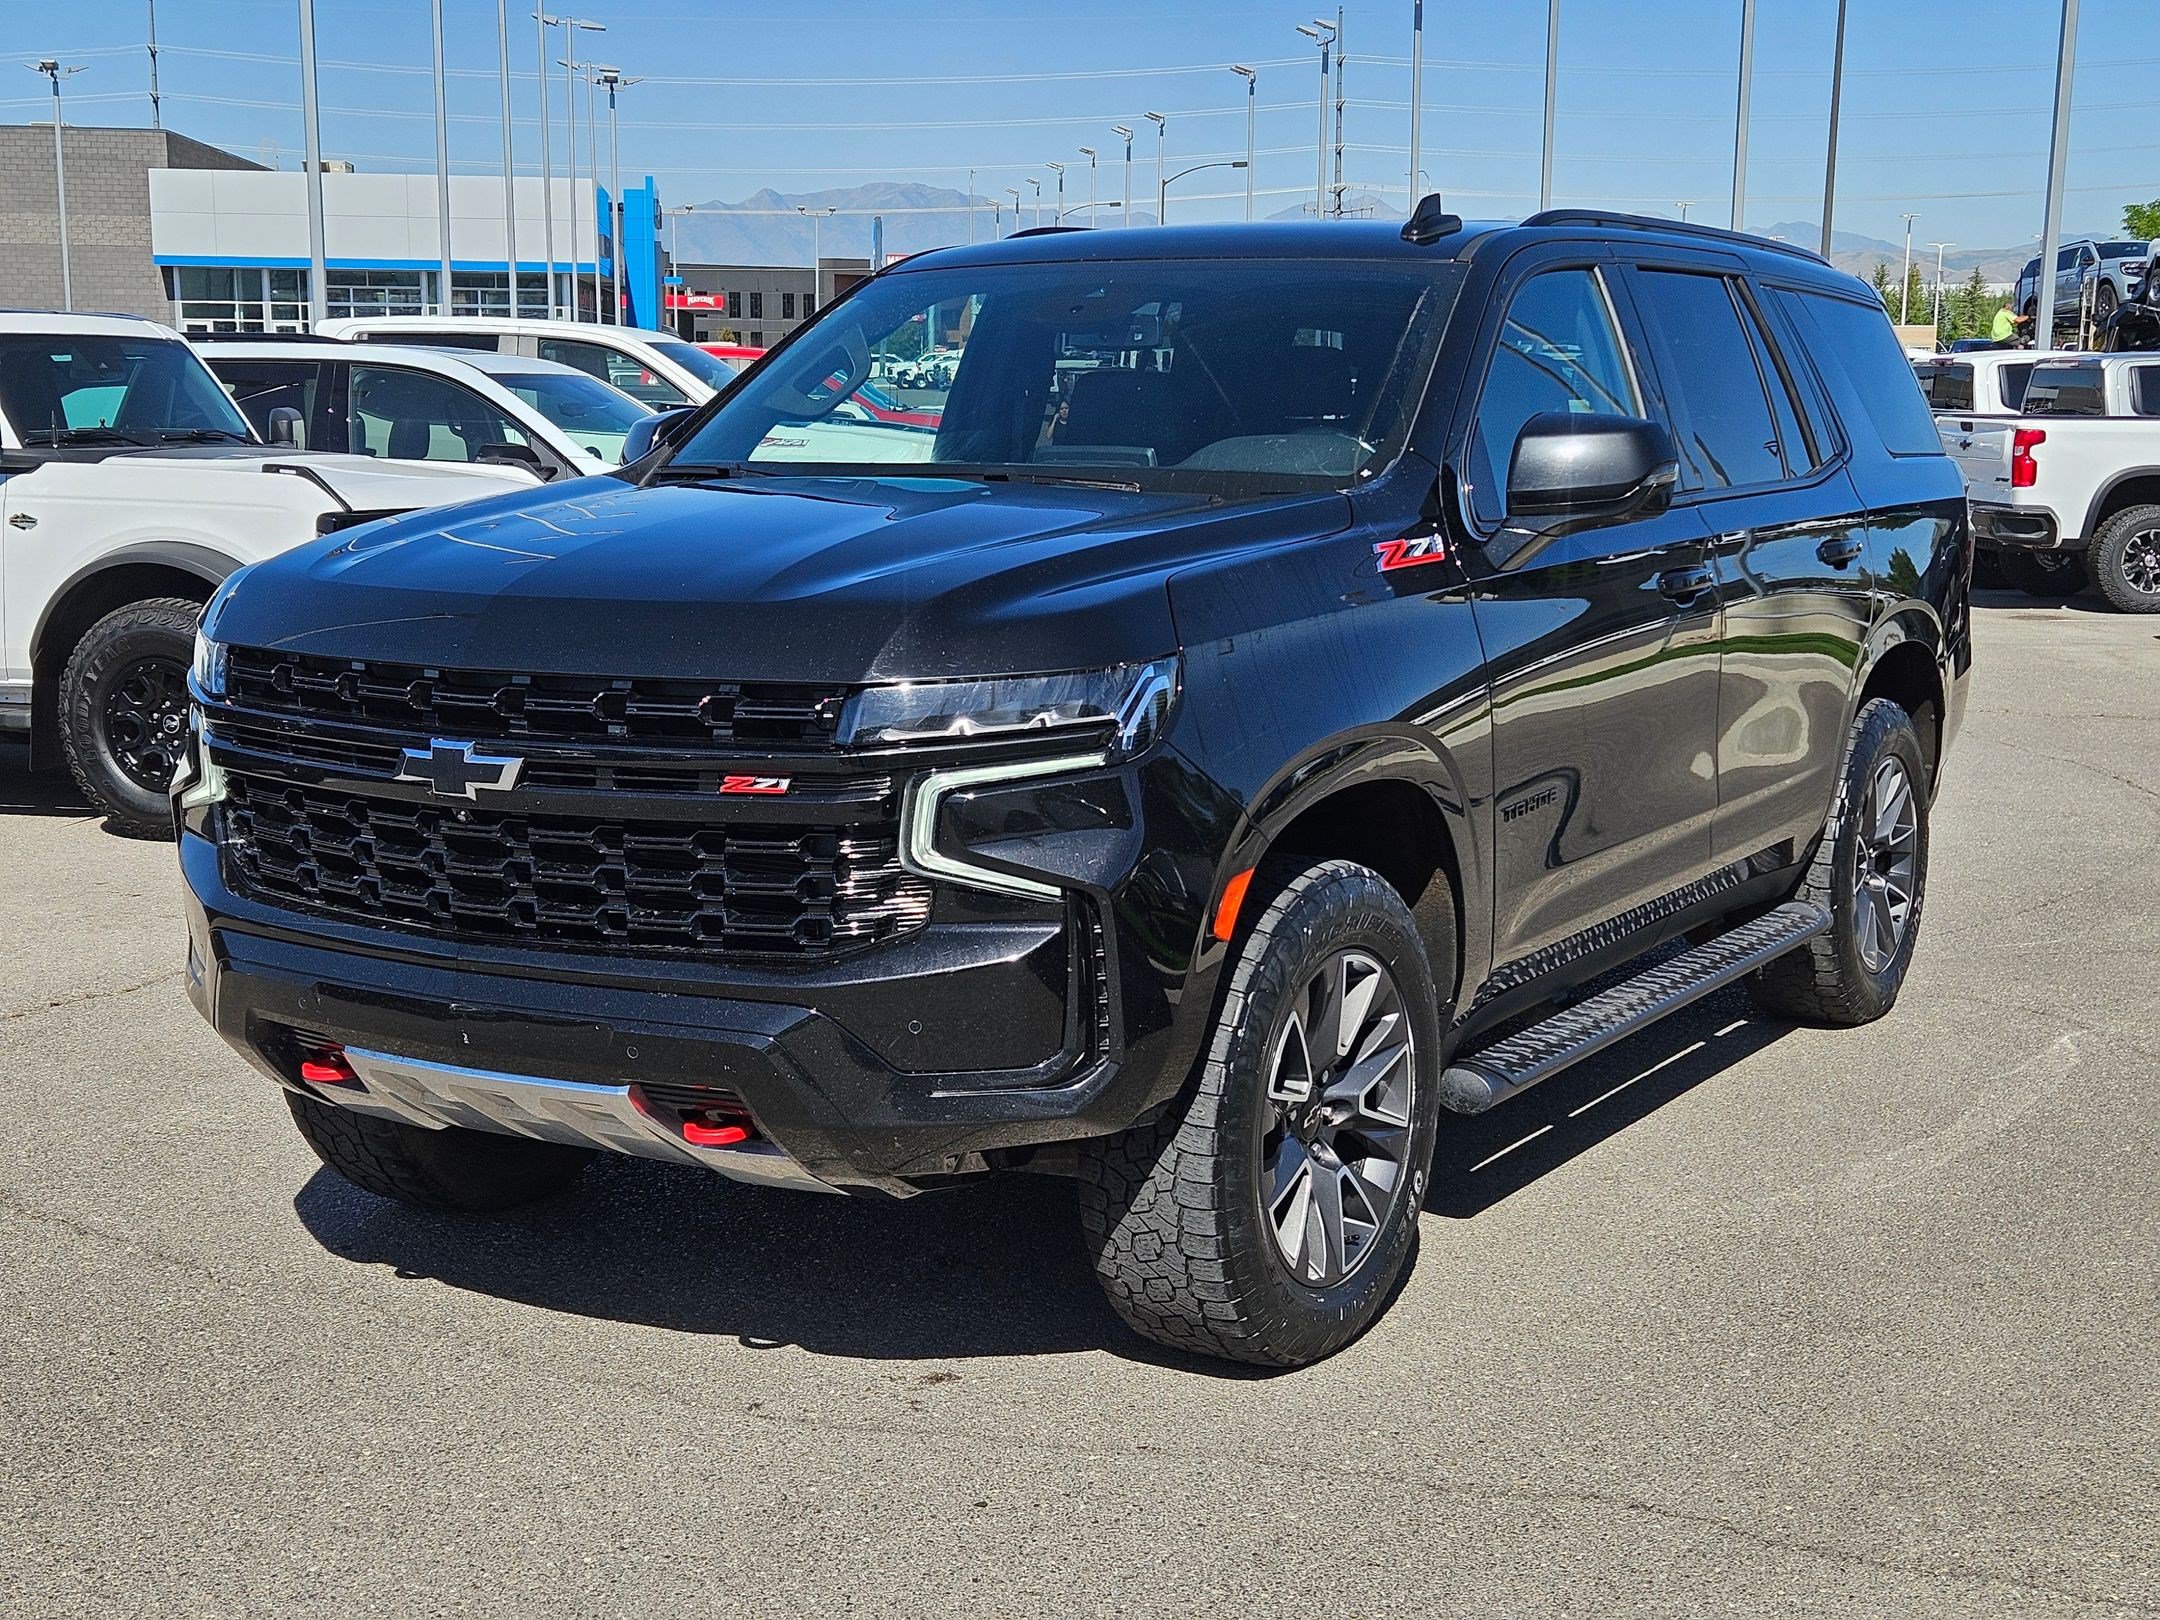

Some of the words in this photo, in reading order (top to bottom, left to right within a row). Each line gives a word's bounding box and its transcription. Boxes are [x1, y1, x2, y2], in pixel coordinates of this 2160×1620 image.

[1372, 534, 1445, 573] Z71
[720, 776, 791, 793] Z71
[1500, 786, 1558, 822] TAHOE
